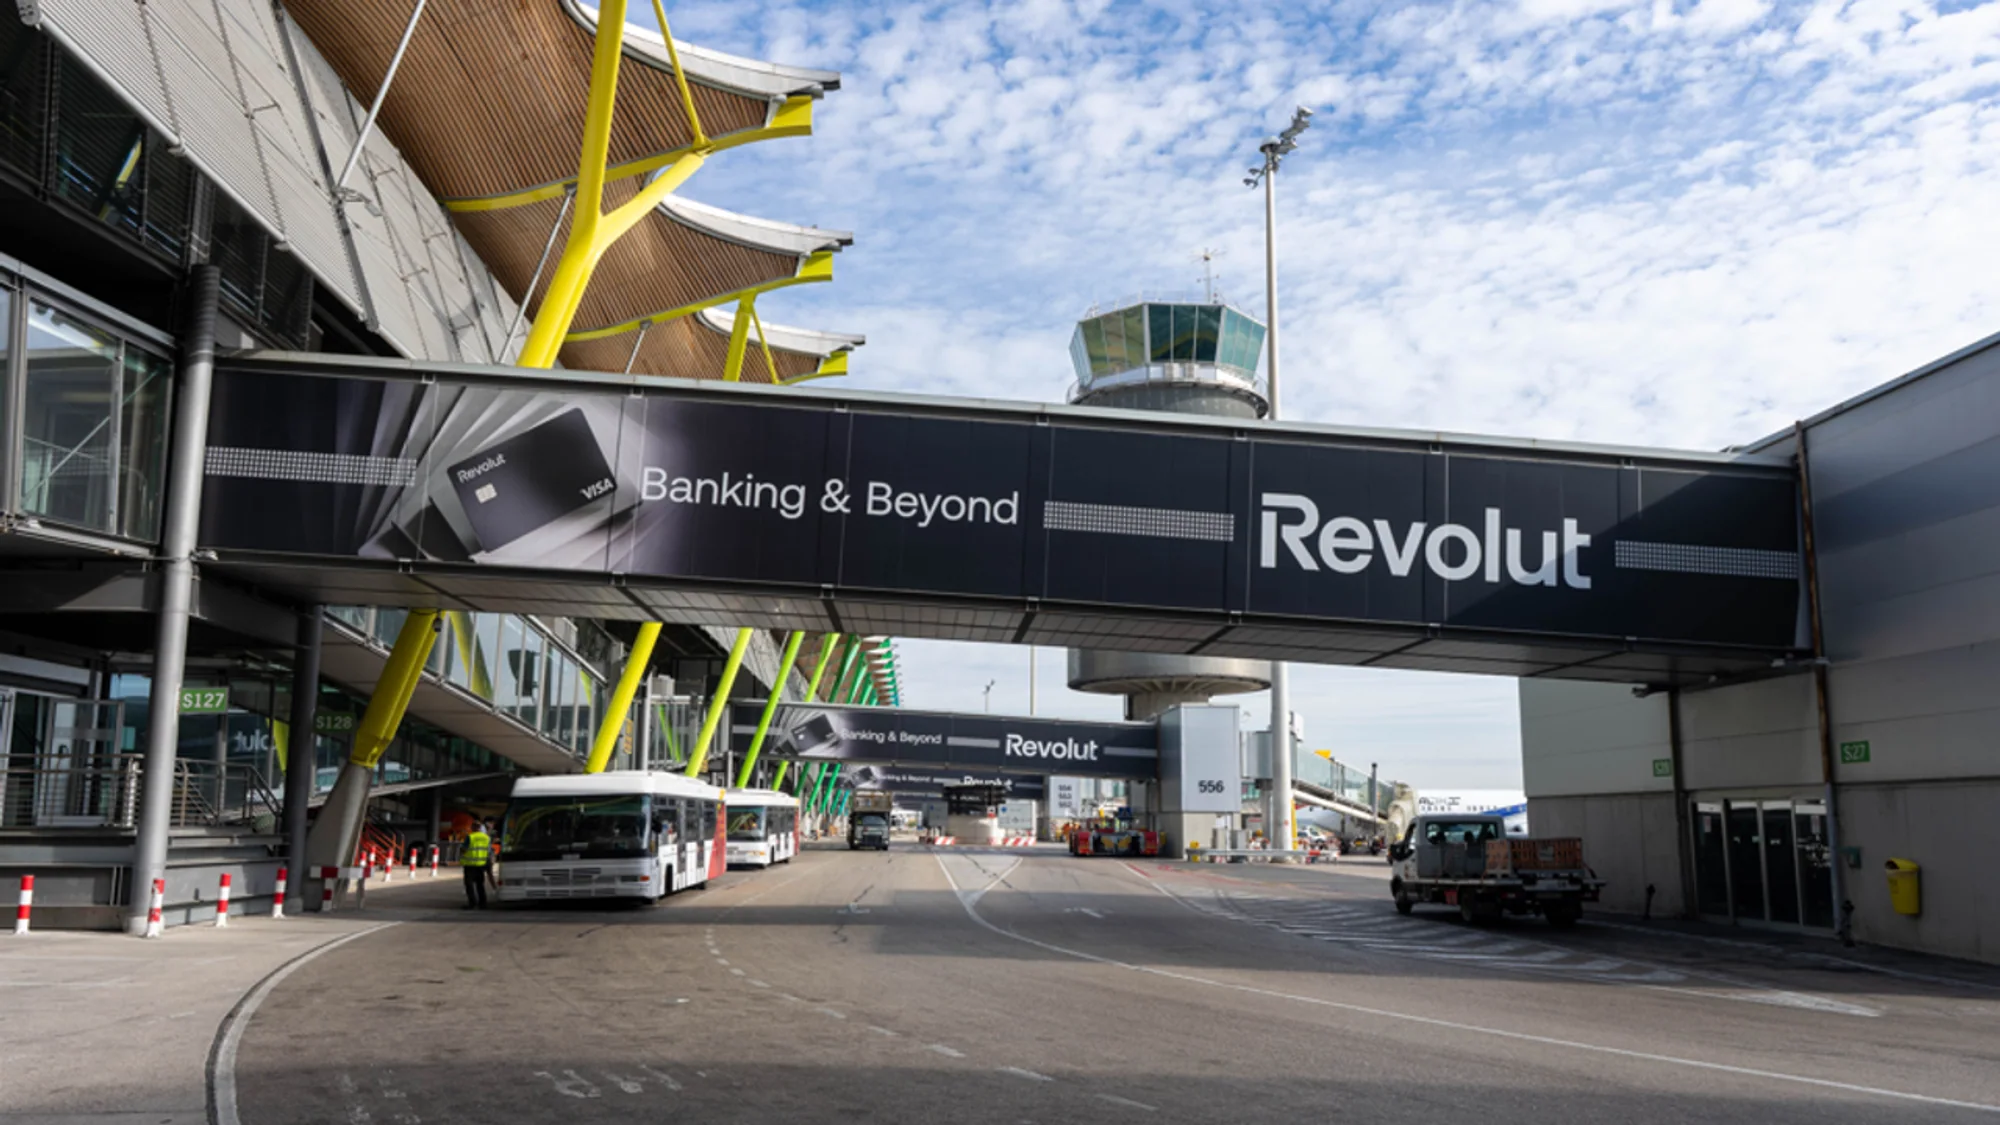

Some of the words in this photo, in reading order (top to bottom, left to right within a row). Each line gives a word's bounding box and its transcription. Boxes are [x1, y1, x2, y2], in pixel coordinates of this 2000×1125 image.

[457, 453, 506, 483] Revolut
[579, 478, 614, 500] VISA
[640, 466, 806, 519] Banking
[820, 478, 851, 515] &
[866, 481, 1019, 528] Beyond
[1260, 492, 1592, 590] Revolut
[182, 692, 226, 709] S127
[315, 715, 353, 730] S128
[841, 727, 885, 744] Banking
[887, 730, 897, 742] &
[899, 730, 942, 746] Beyond
[1005, 733, 1098, 761] Revolut
[1843, 744, 1866, 761] S27
[1198, 780, 1225, 793] 556
